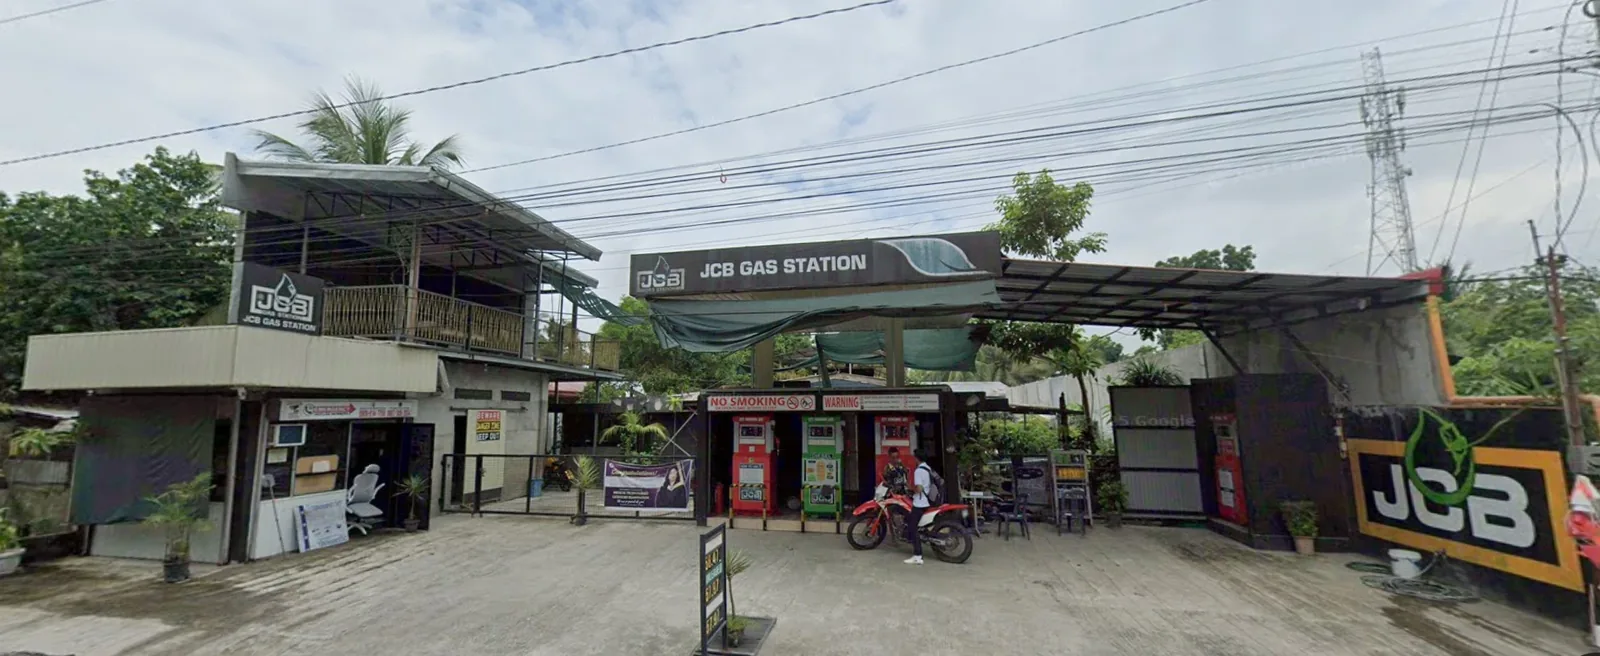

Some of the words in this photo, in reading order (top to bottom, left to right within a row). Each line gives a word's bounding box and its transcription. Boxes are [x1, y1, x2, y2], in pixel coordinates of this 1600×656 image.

[700, 263, 734, 278] JCB
[740, 260, 777, 276] GAS
[783, 254, 866, 273] STATION
[641, 273, 681, 288] JCB
[257, 293, 308, 316] JCB
[243, 315, 261, 324] JCB
[262, 317, 281, 327] GAS
[282, 320, 317, 332] STATION
[710, 397, 728, 406] NO
[730, 397, 786, 406] SMOKING
[824, 397, 860, 408] WARNING
[476, 411, 500, 420] BEWARE
[1372, 463, 1536, 549] JCB
